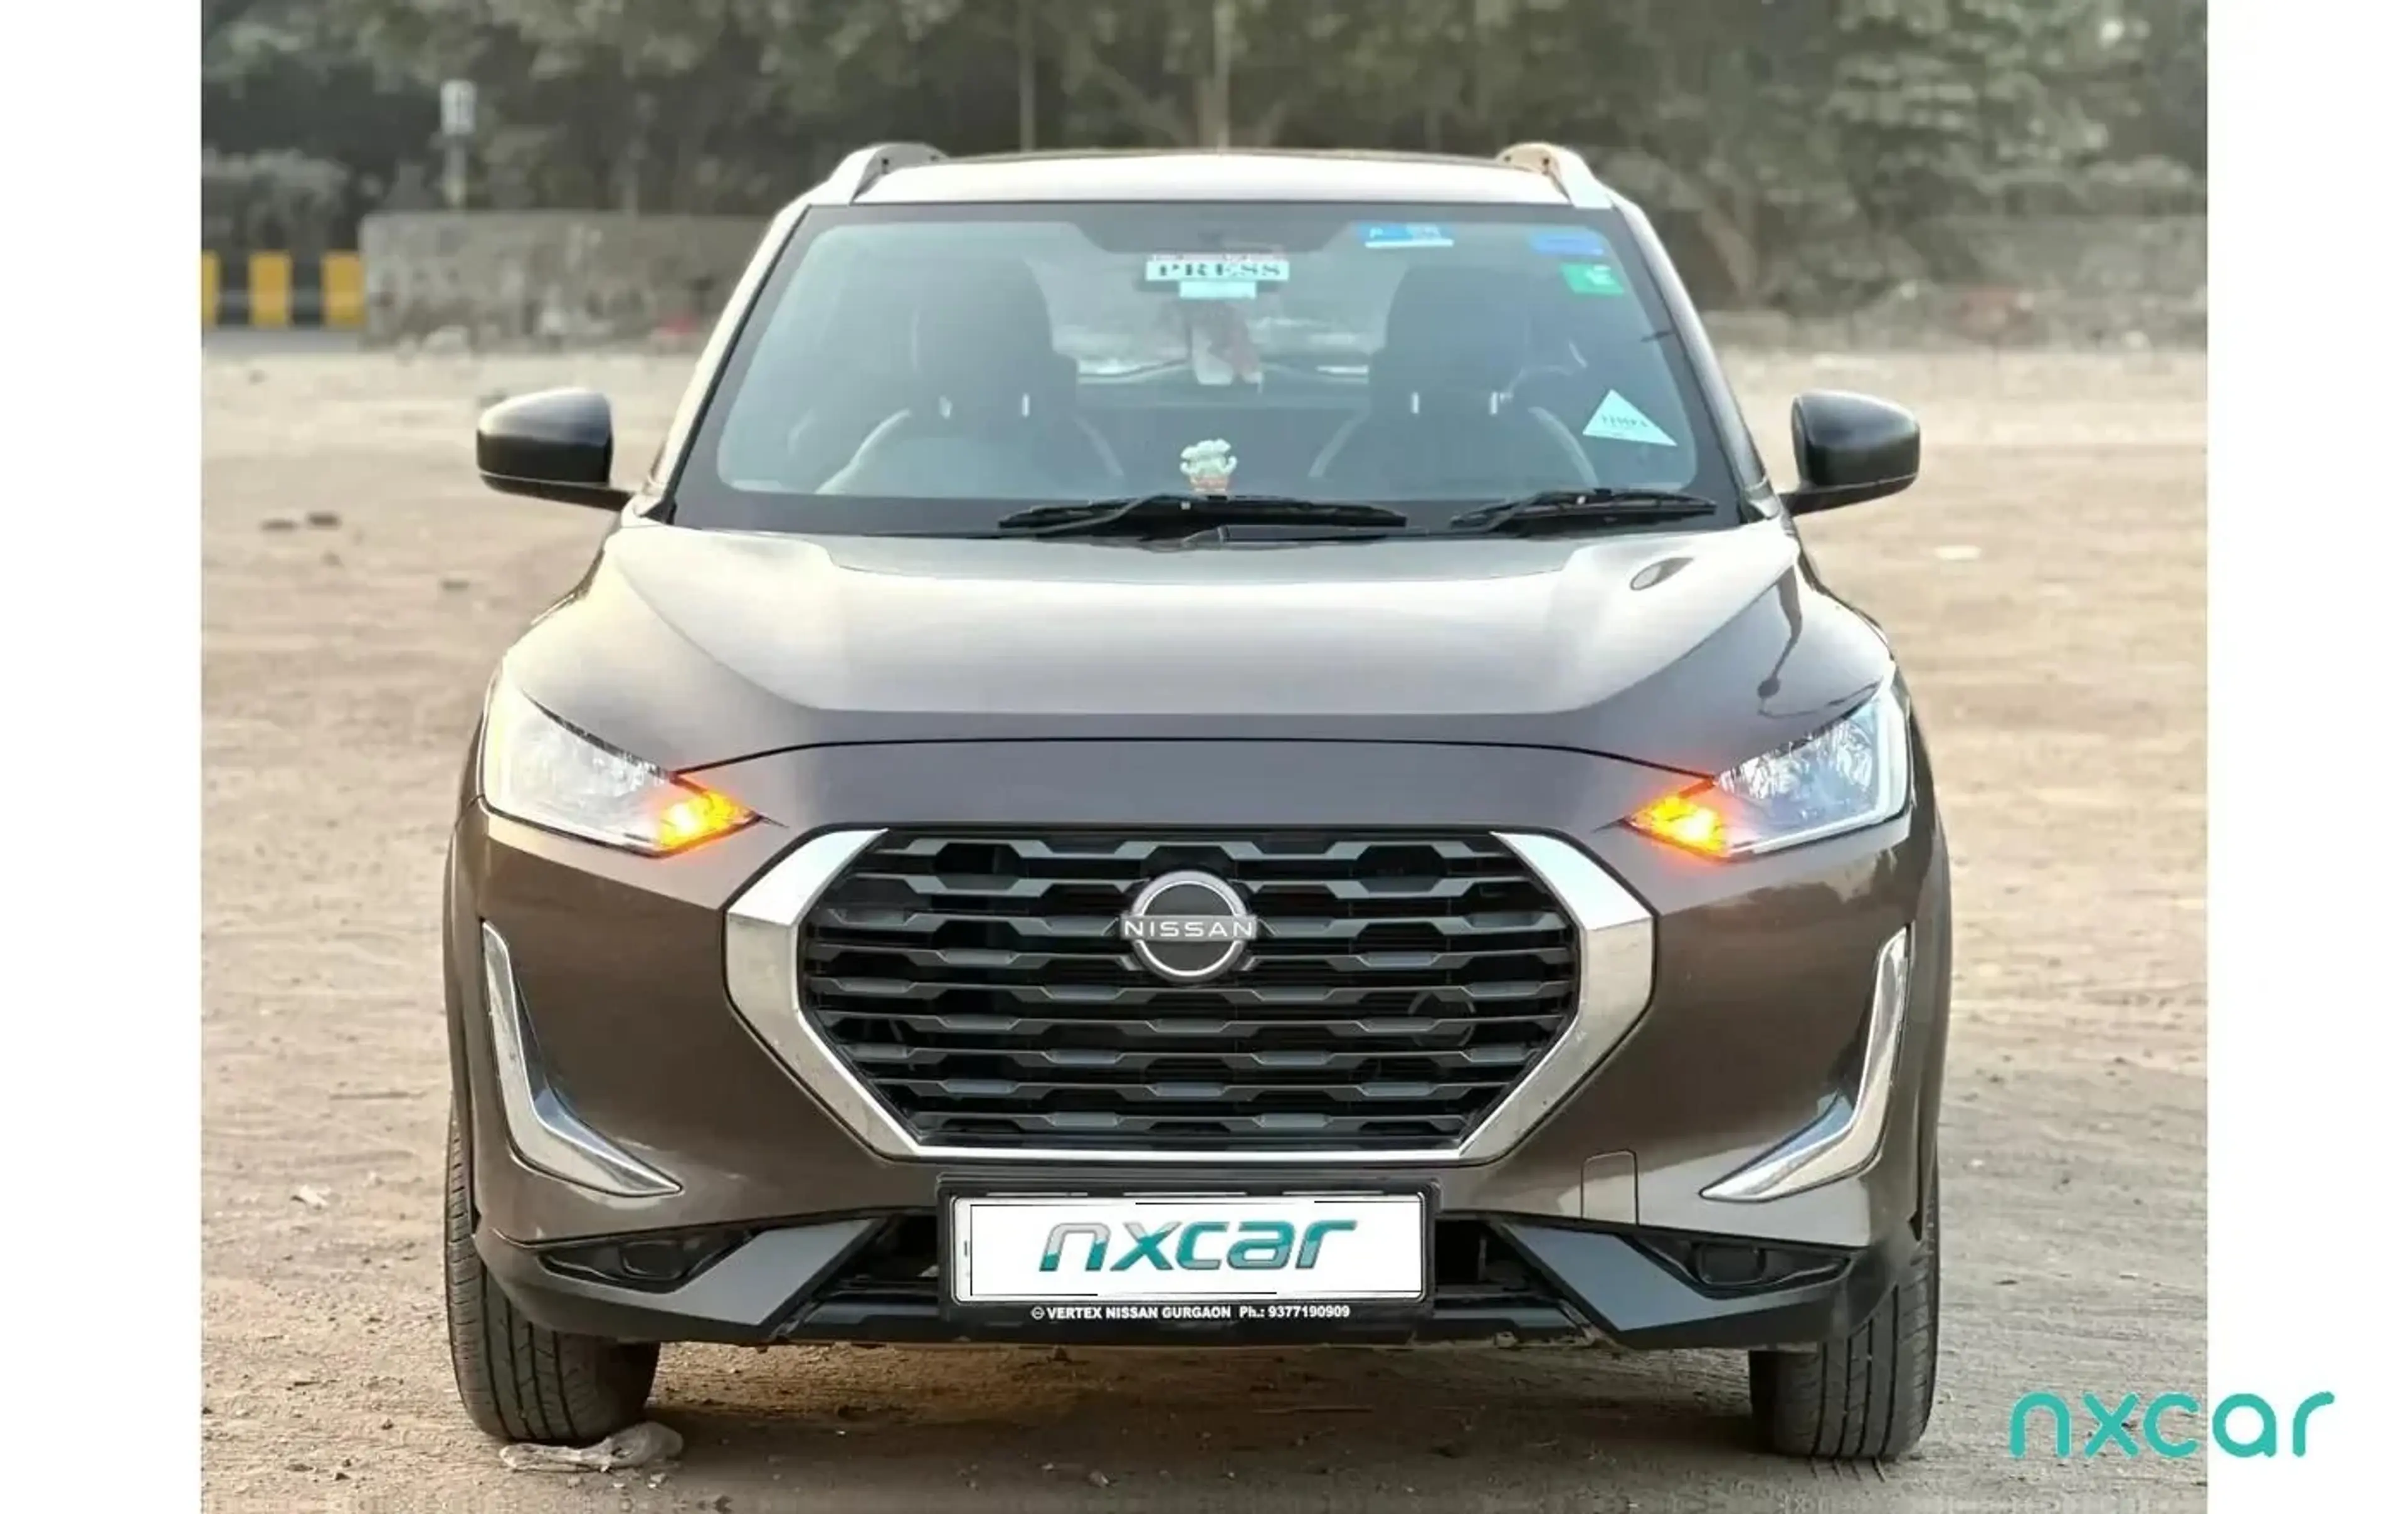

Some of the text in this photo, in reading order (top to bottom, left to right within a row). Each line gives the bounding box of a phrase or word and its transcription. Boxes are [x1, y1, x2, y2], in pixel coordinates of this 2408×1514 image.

[1158, 262, 1281, 277] PRESS
[1124, 921, 1252, 938] NISSAN
[1047, 1305, 1350, 1319] VERTEX NISSAN GURGAON Ph.: 9377190909
